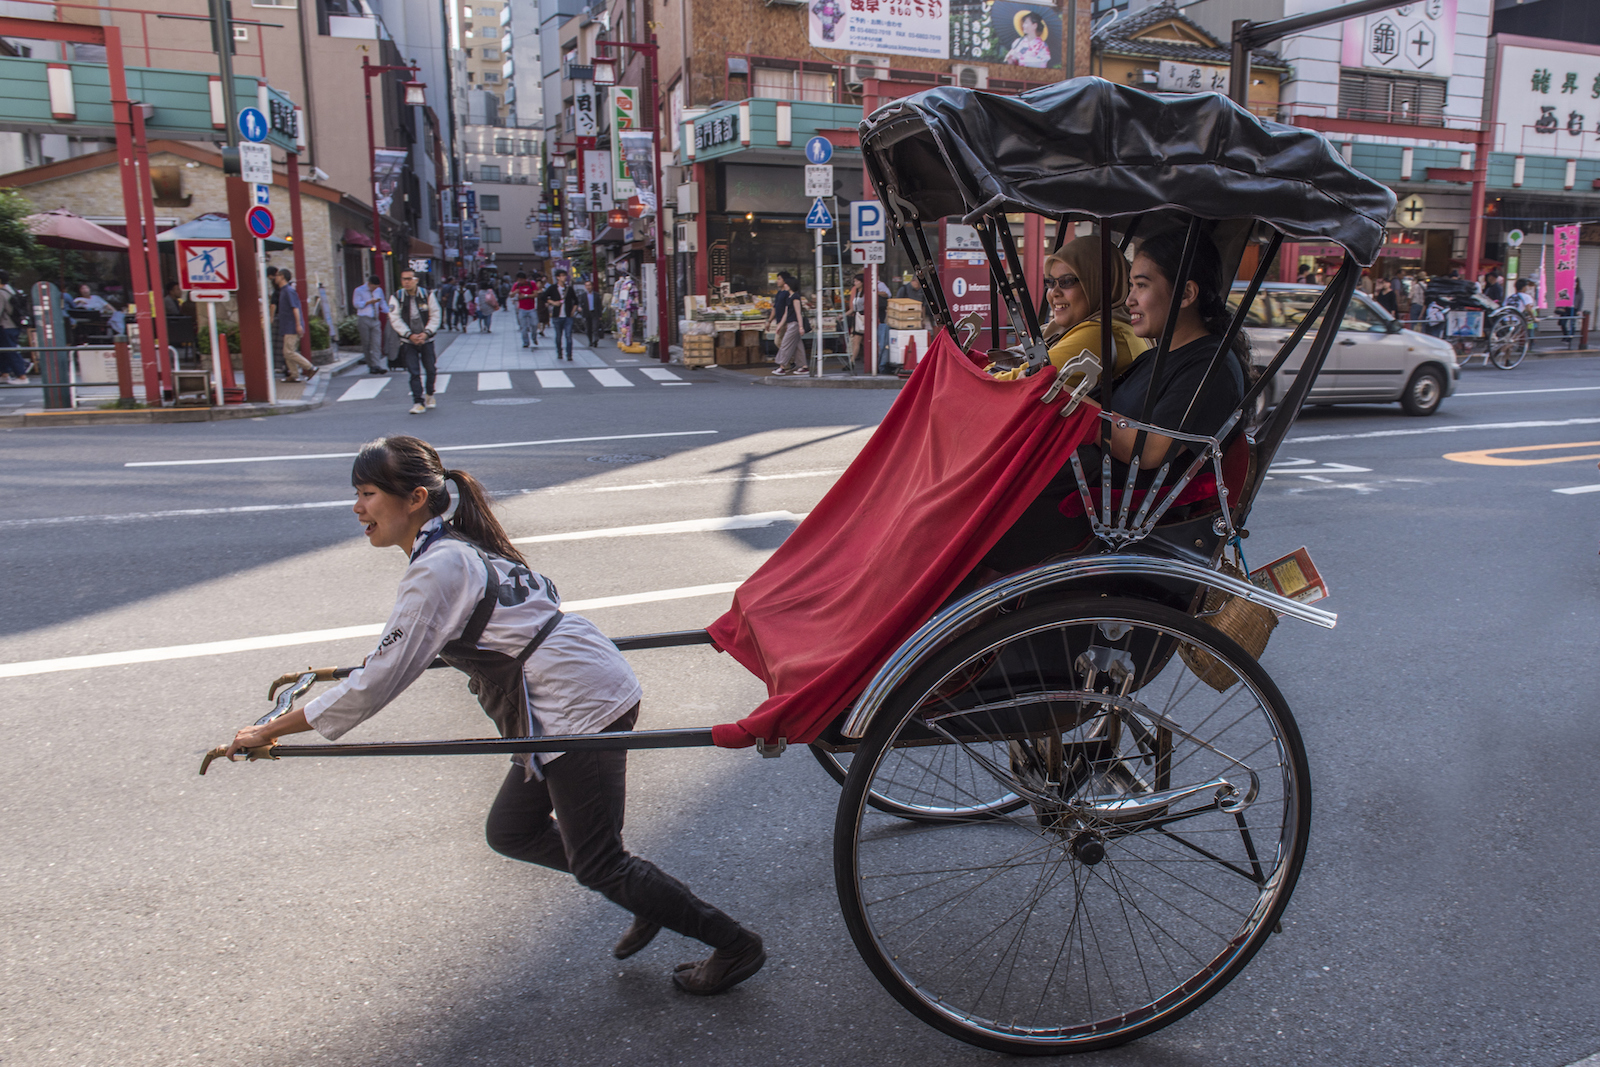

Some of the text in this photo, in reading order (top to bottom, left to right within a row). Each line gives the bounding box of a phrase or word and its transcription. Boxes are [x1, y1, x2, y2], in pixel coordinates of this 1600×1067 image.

[971, 20, 983, 58] きもの
[981, 1, 992, 50] レンタル
[694, 113, 736, 149] 雷門東部
[1535, 105, 1600, 142] 西む
[858, 205, 880, 236] P
